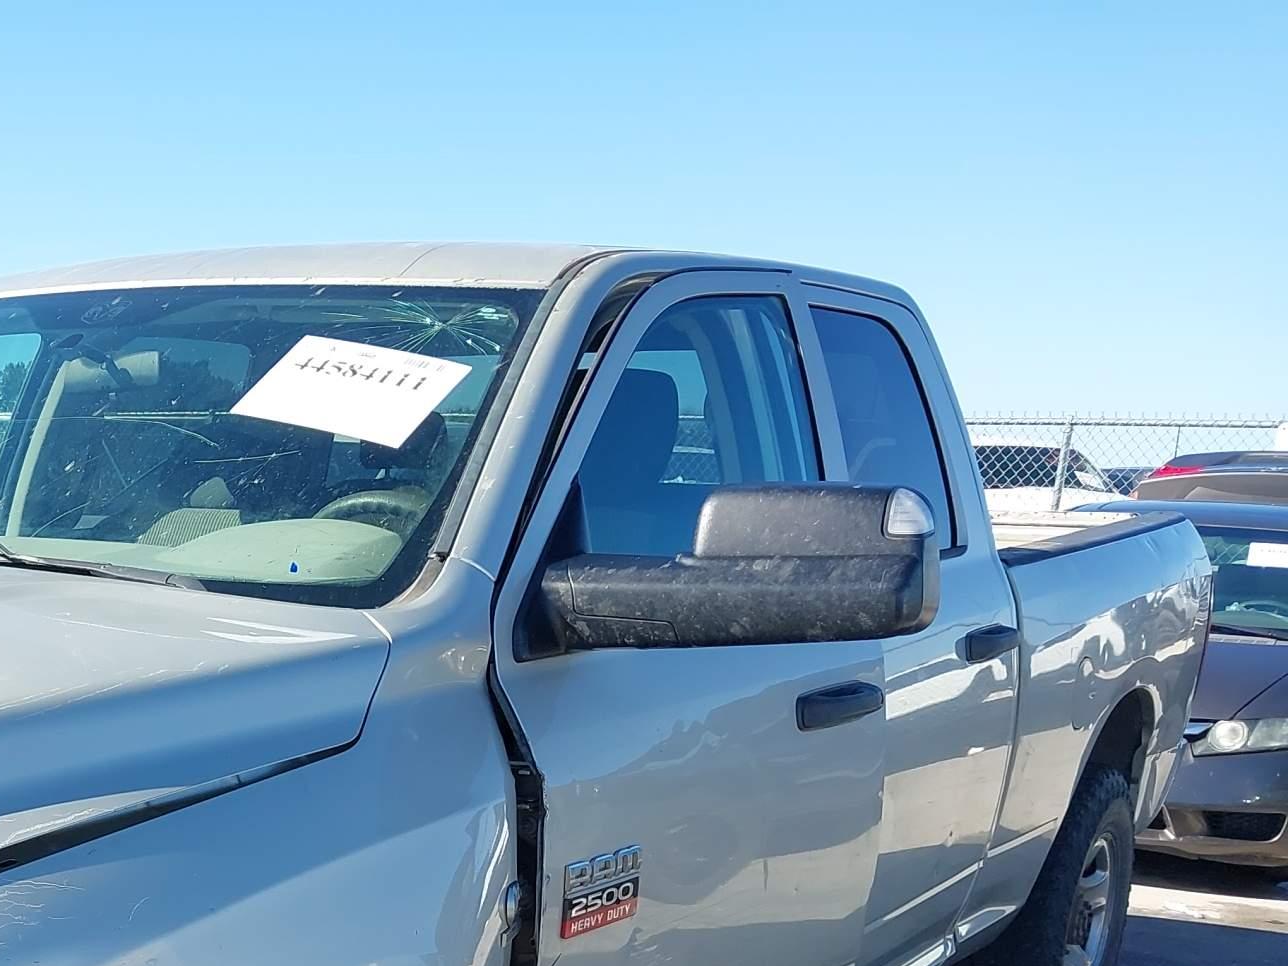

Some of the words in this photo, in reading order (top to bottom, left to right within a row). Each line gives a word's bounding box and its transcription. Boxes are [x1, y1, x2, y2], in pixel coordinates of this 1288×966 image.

[295, 356, 427, 390] 44584111
[565, 844, 642, 892] RAM
[570, 883, 634, 918] 2500
[570, 912, 604, 934] HEAVY
[606, 902, 632, 922] DUTY
